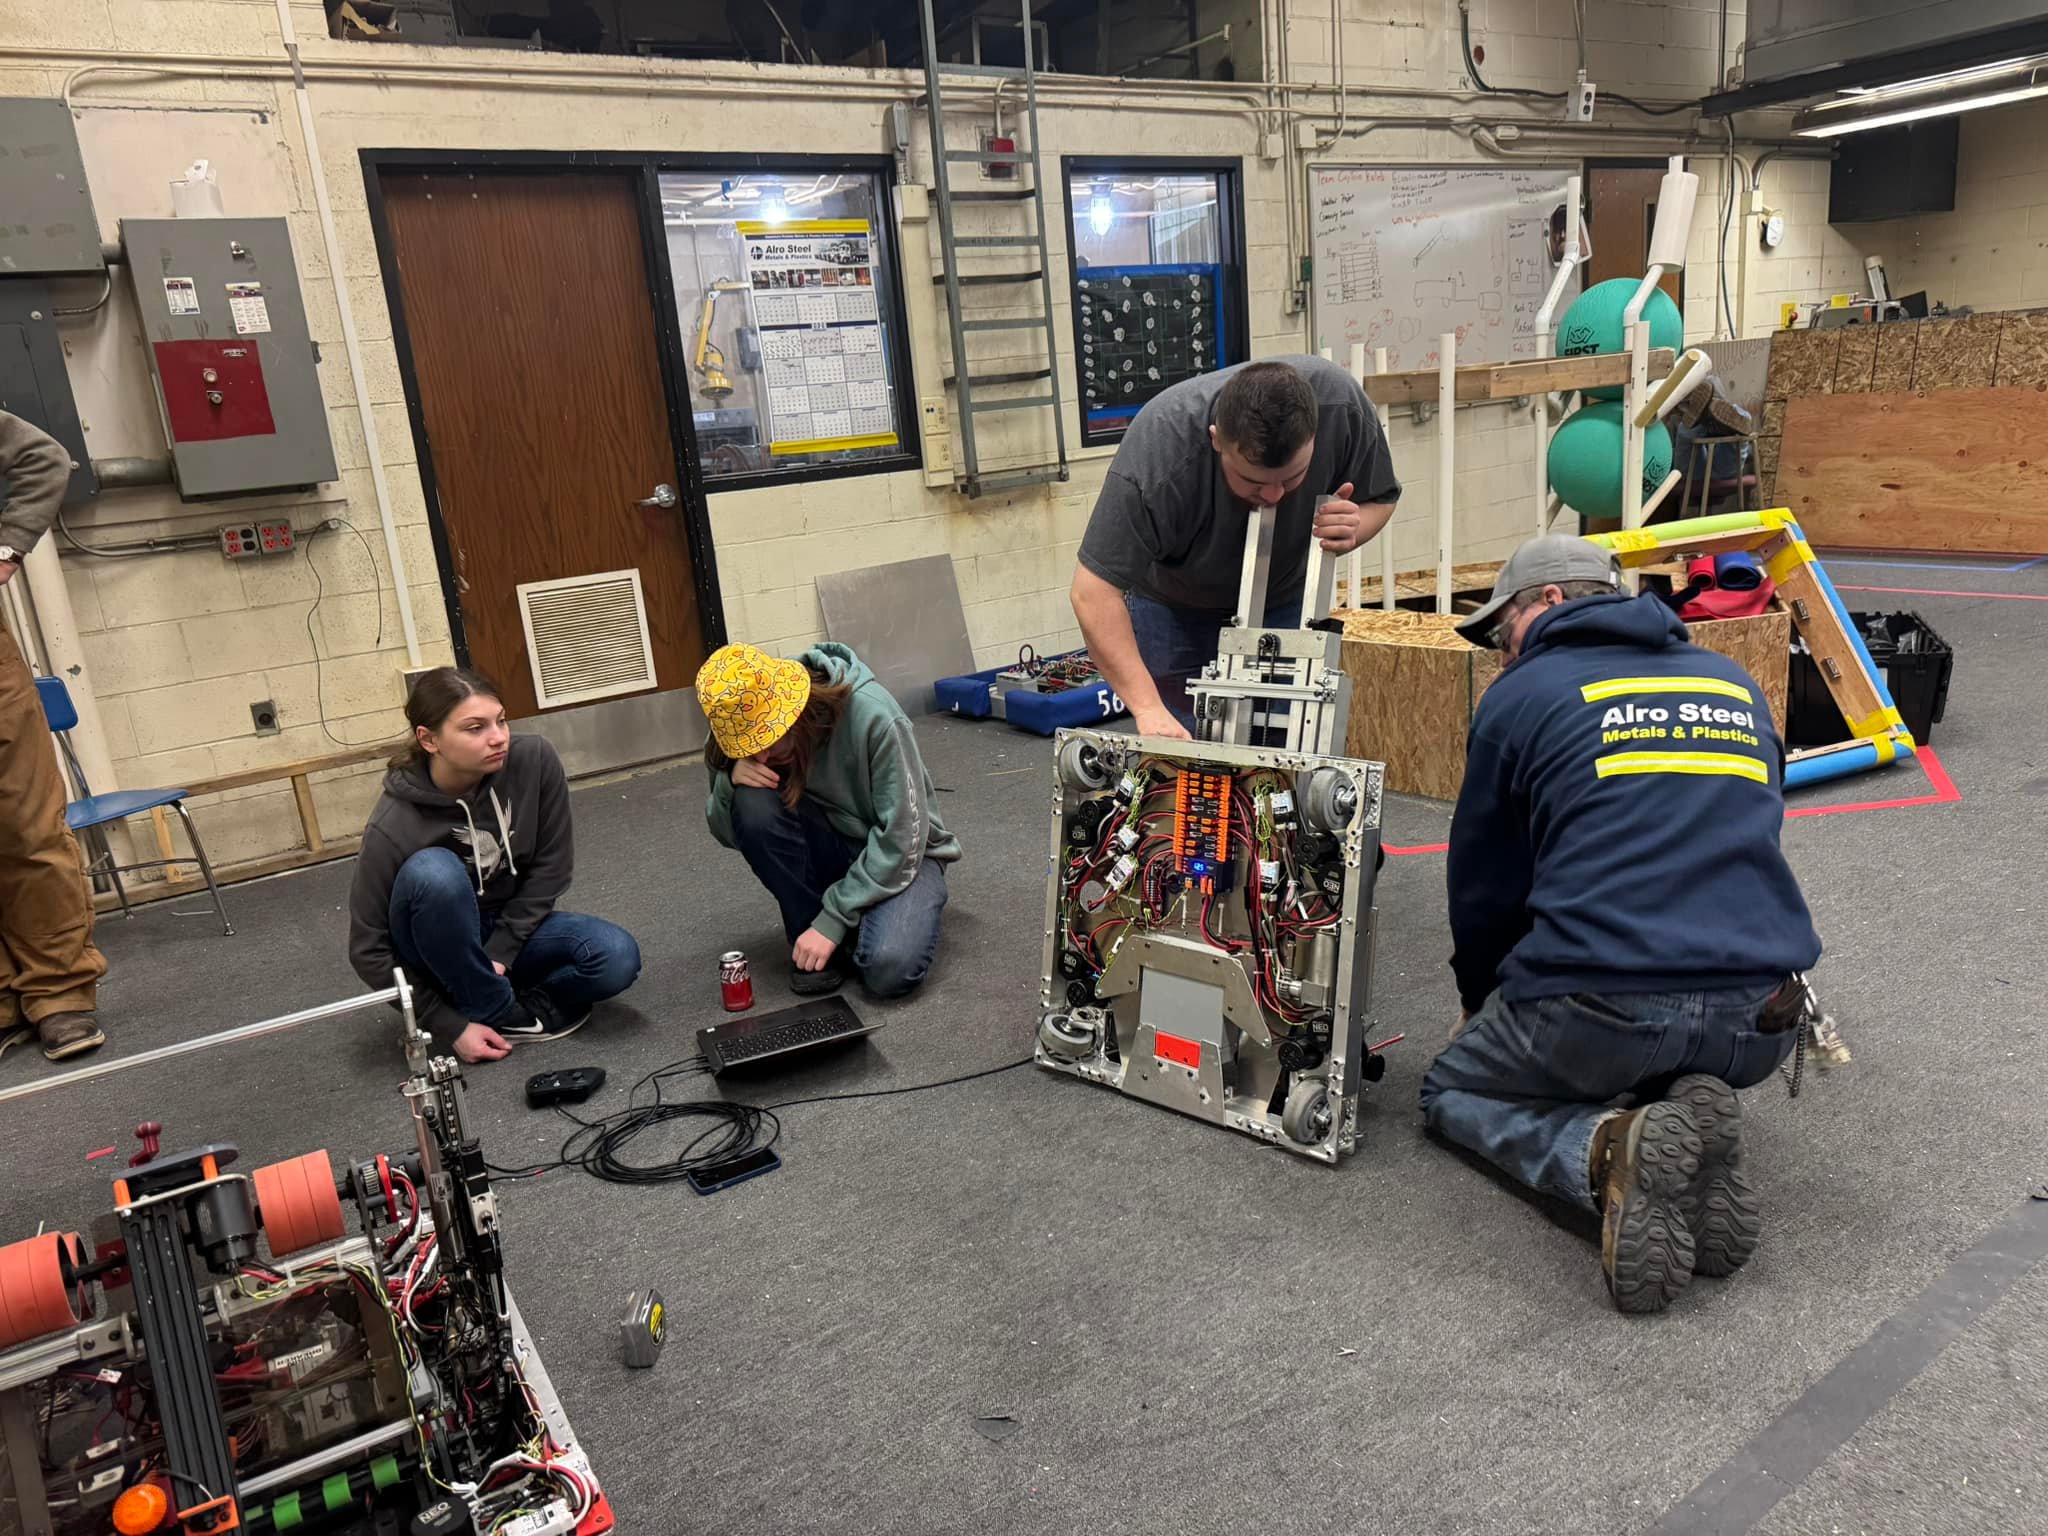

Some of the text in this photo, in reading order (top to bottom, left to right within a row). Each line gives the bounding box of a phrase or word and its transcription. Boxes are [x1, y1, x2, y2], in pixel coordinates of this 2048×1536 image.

[765, 244, 811, 254] Alro Steel
[1600, 703, 1755, 729] Alro Steel
[1602, 725, 1759, 746] Metals & Plastics
[1312, 1023, 1329, 1033] NEO
[418, 1501, 450, 1524] NEO
